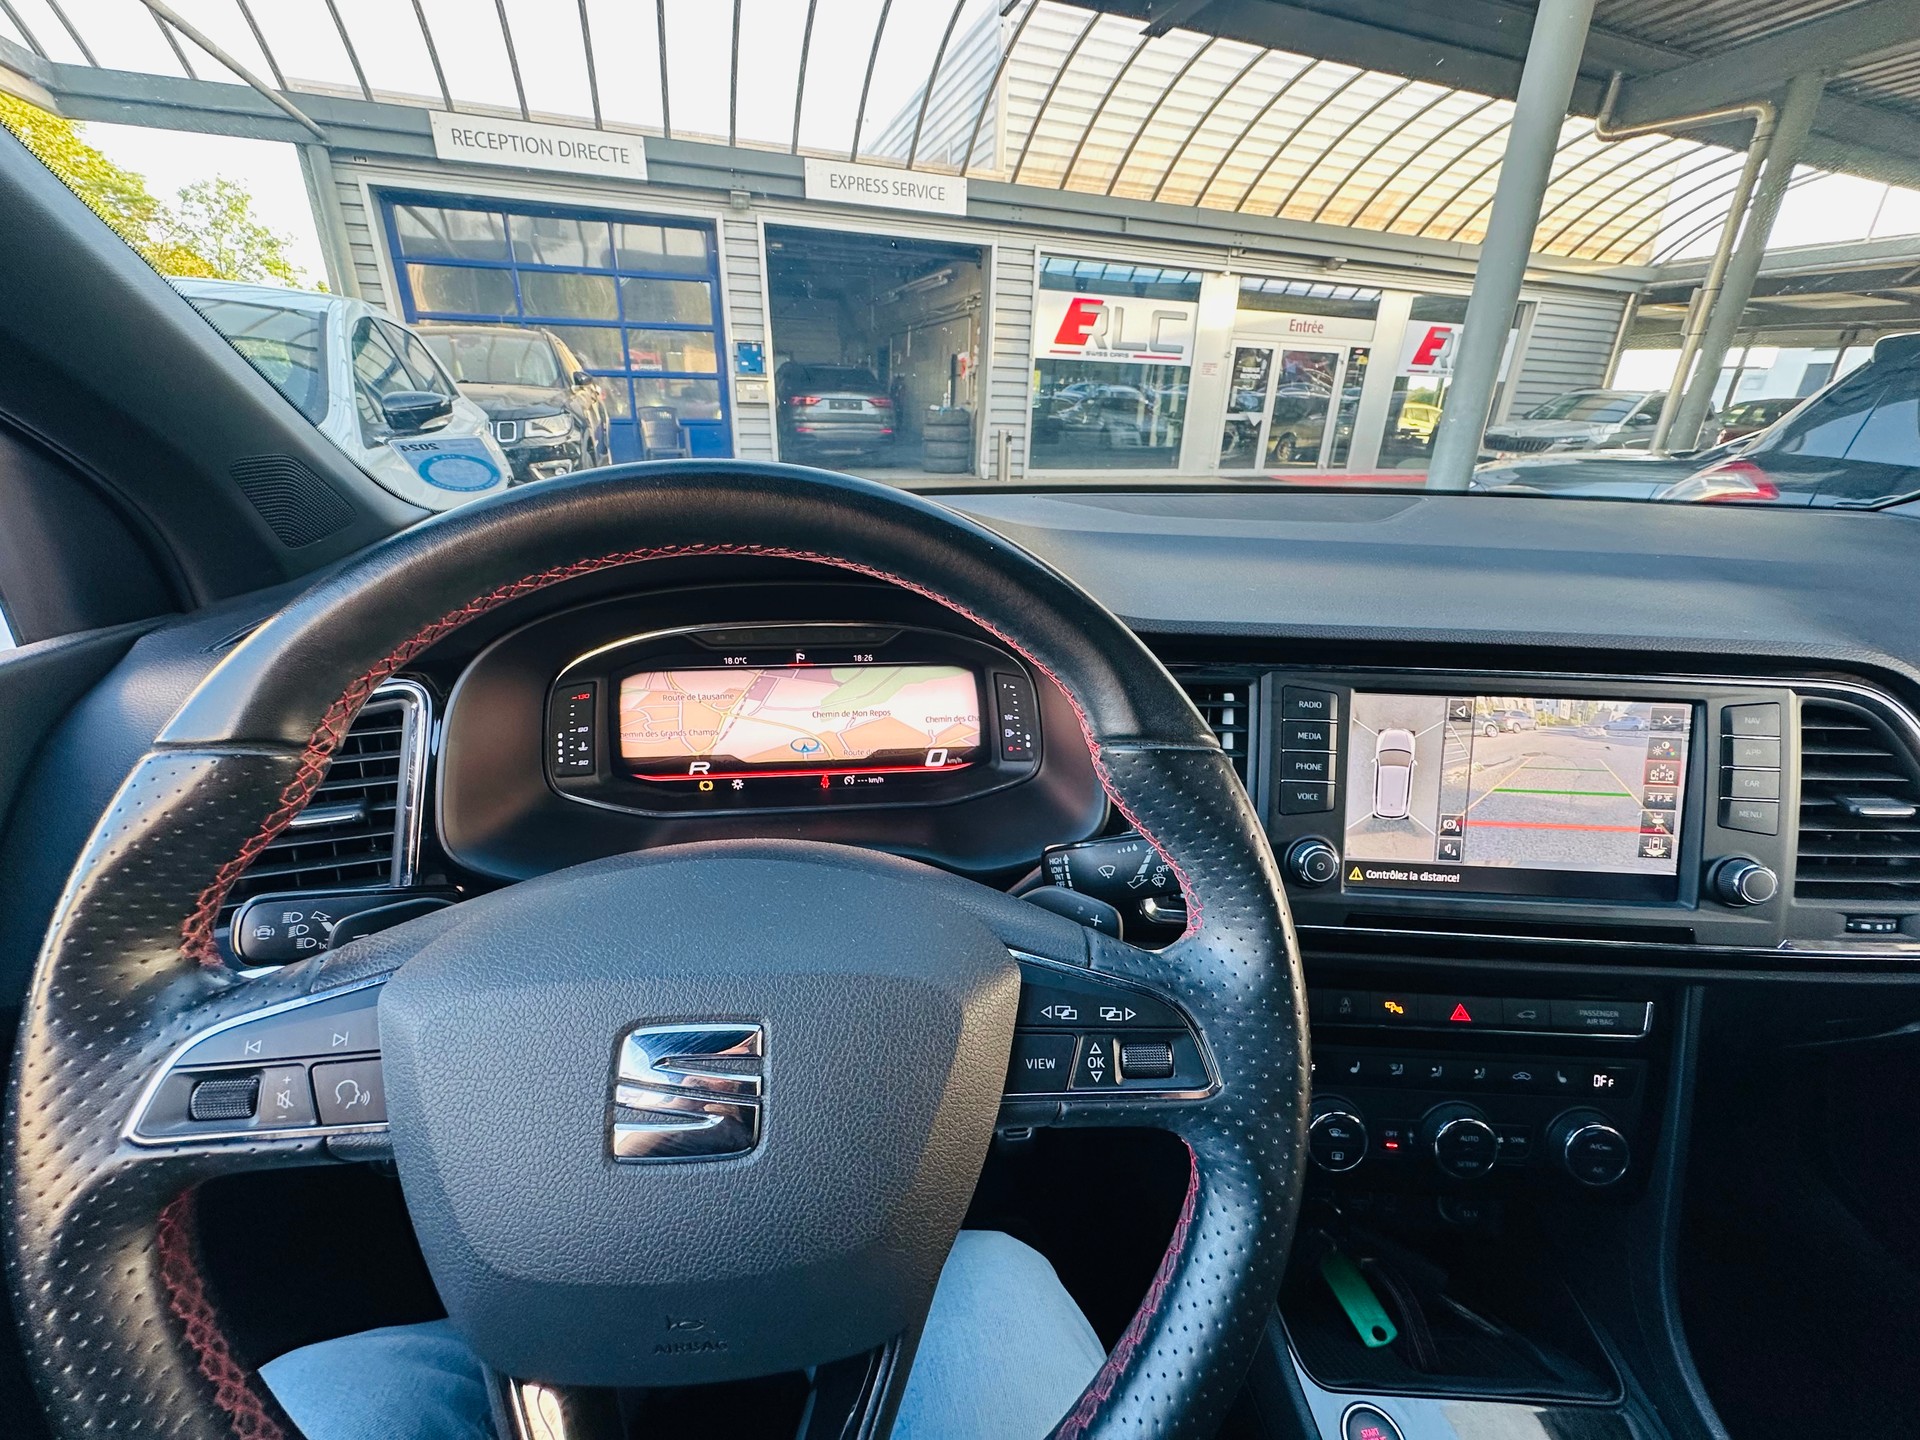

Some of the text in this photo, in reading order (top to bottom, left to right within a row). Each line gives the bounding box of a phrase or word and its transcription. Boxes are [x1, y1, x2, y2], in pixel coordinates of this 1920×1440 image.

[450, 127, 630, 165] RECEPTION DIRECTE
[829, 173, 946, 202] EXPRESS SERVICE
[1054, 297, 1189, 354] ERLC
[1288, 317, 1325, 336] Entrée
[1085, 350, 1130, 359] SWISS CARS
[723, 656, 748, 665] 18.0°C
[853, 654, 873, 662] 18:26
[662, 692, 735, 702] Route de Lausanne
[1298, 699, 1322, 710] RADIO
[812, 709, 892, 719] Chemin de Mon Repos
[925, 715, 952, 724] Chemin
[953, 715, 966, 723] des
[1744, 716, 1762, 726] NAV
[645, 730, 660, 738] des
[660, 729, 687, 738] Grands
[688, 728, 720, 739] Champs
[1297, 731, 1322, 742] MEDIA
[843, 749, 866, 757] Route
[925, 748, 948, 767] 0
[1744, 748, 1762, 757] APP
[688, 761, 711, 776] R
[1295, 761, 1322, 772] PHONE
[1744, 779, 1761, 788] CAR
[1296, 792, 1319, 801] VOICE
[1738, 810, 1762, 819] MENU
[1049, 857, 1062, 865] HIGH
[1051, 866, 1063, 874] LOW
[1156, 865, 1170, 873] OFF
[1365, 868, 1460, 883] Contrôlez la distance!
[1579, 1009, 1620, 1018] PASSENGER
[1586, 1017, 1598, 1025] AIR
[1025, 1058, 1056, 1070] VIEW
[1087, 1056, 1106, 1069] OK
[1384, 1129, 1399, 1139] OFF
[1459, 1134, 1479, 1143] AUTO
[1510, 1136, 1527, 1145] SYNC
[1360, 1427, 1380, 1437] START
